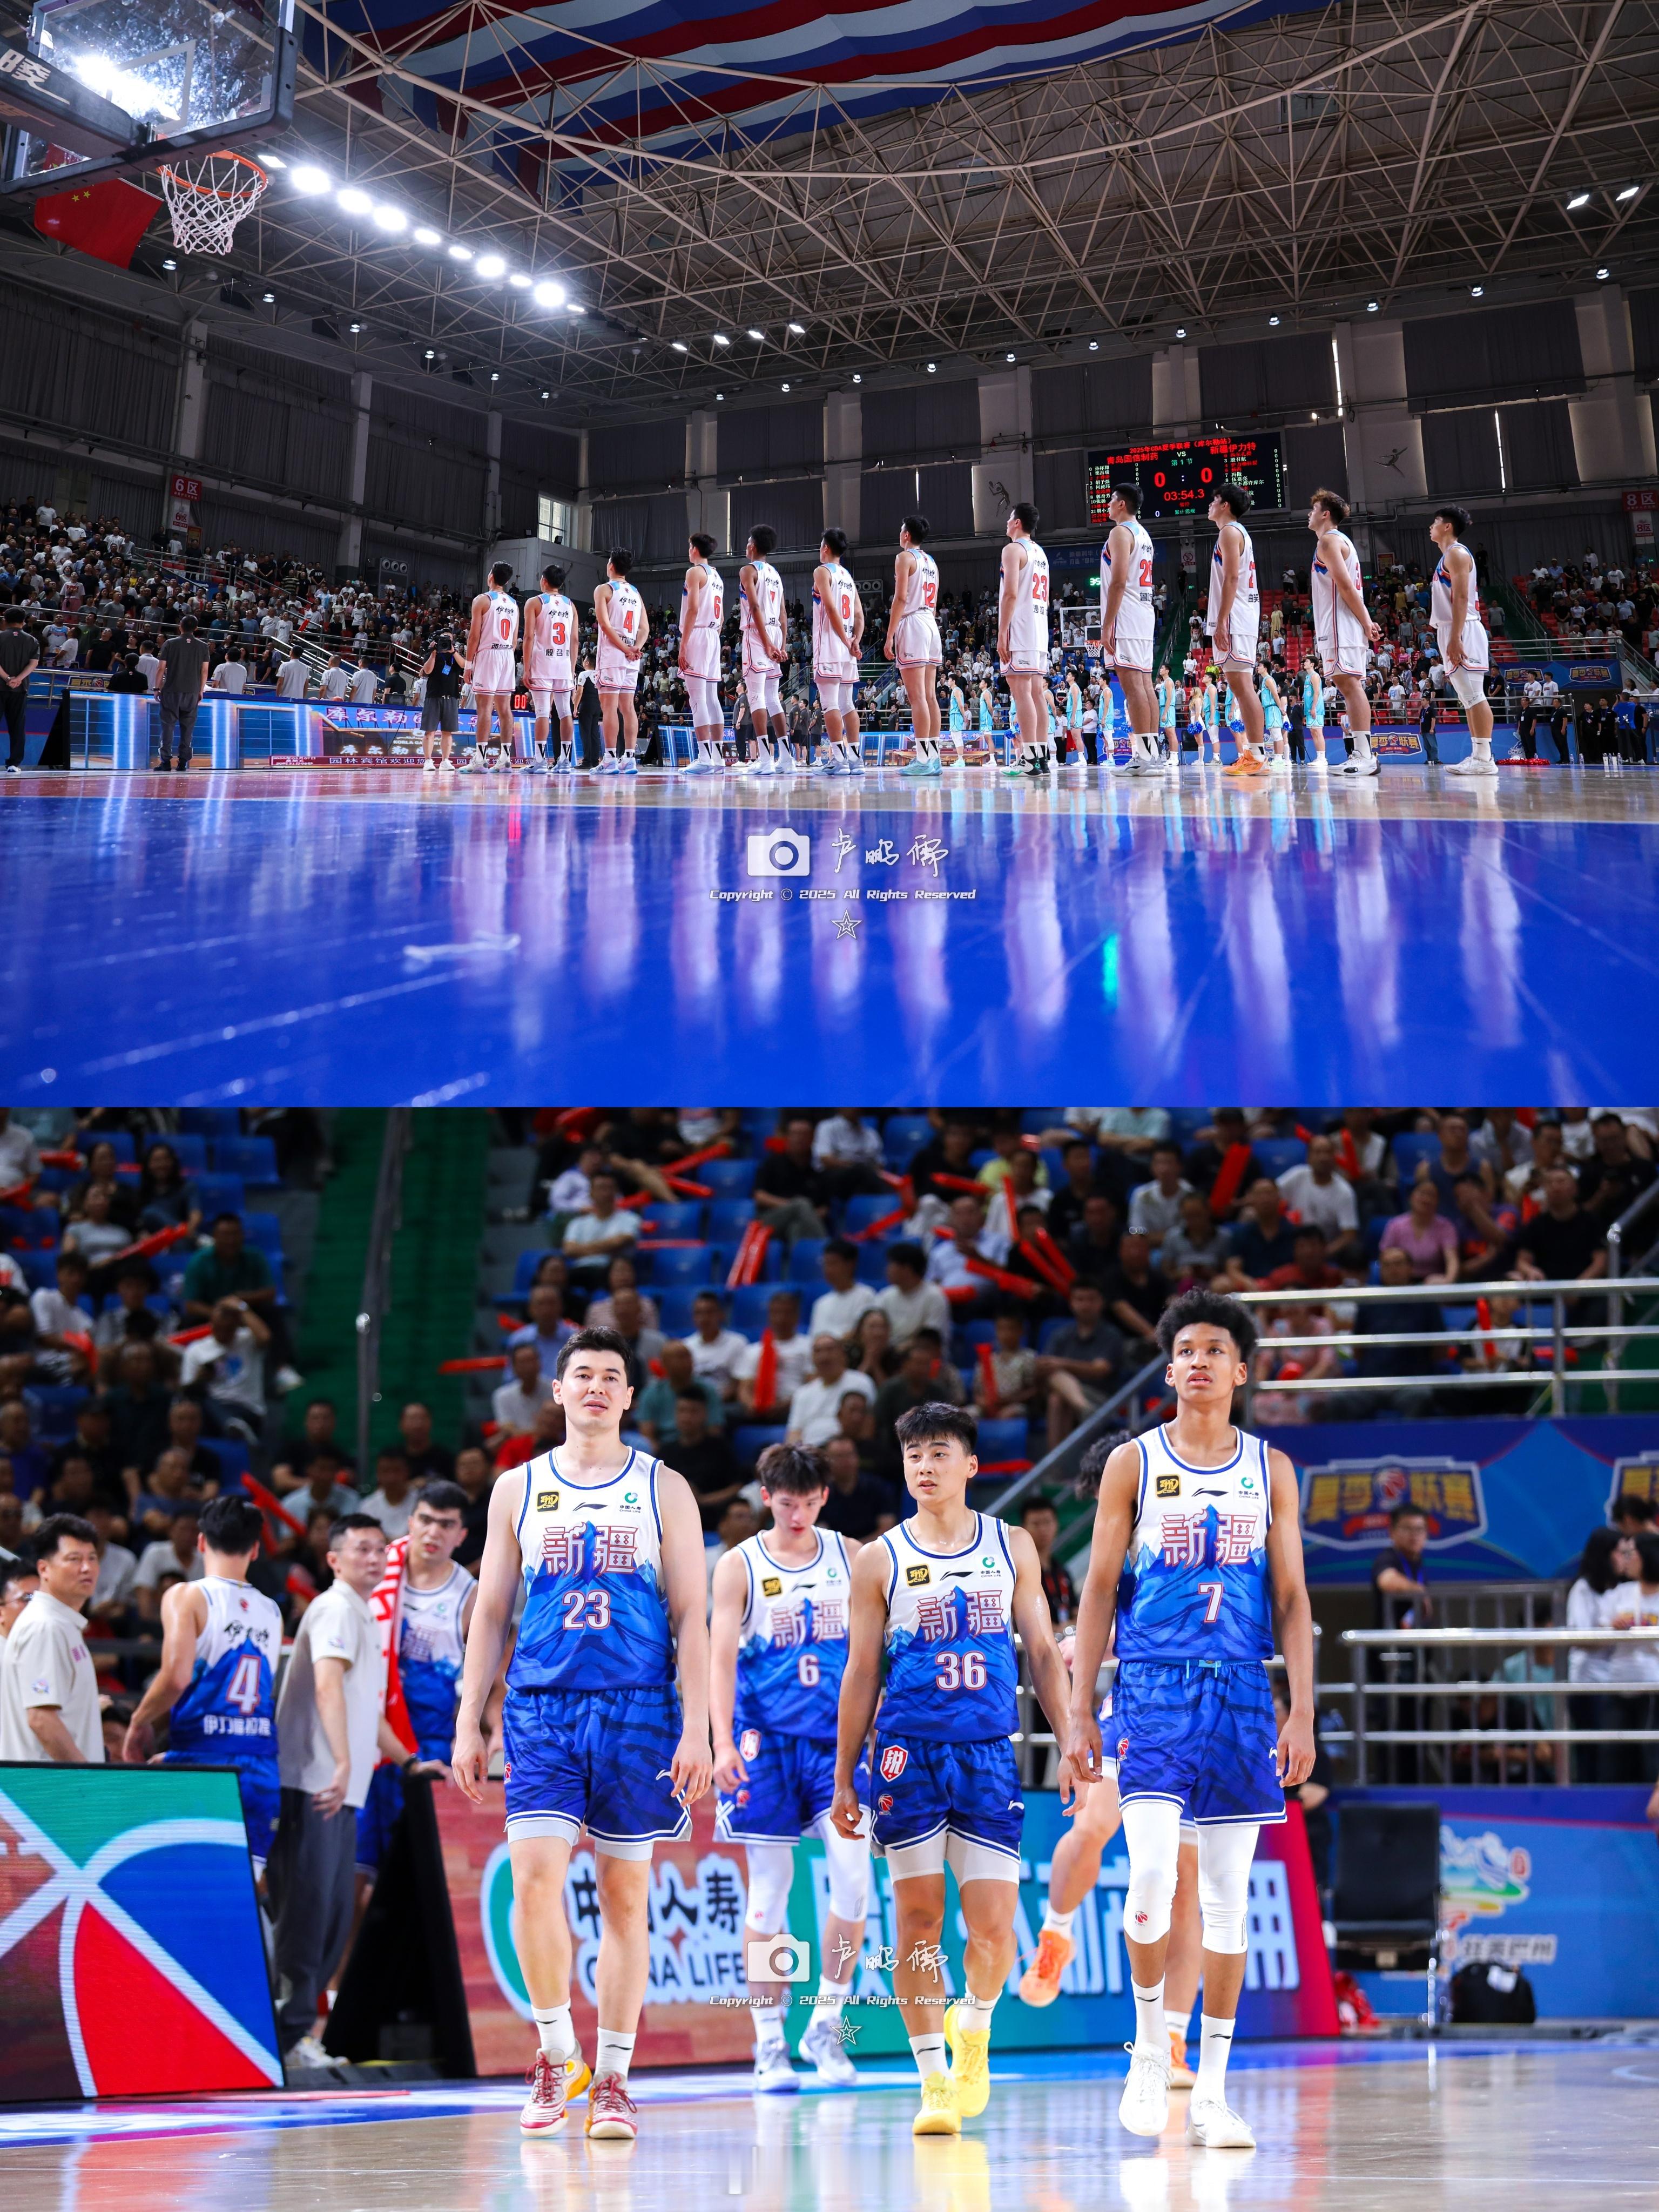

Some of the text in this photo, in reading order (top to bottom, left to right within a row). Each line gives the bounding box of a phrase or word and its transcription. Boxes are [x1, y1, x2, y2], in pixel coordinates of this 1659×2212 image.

[1107, 453, 1158, 464] 青岛国信制药
[1171, 458, 1192, 466] 第1节
[1210, 442, 1256, 454] 新疆伊力特
[1155, 472, 1165, 487] 0
[1201, 468, 1213, 483] 0
[1164, 488, 1205, 501] 03:54.3
[922, 582, 936, 608] 12
[1033, 573, 1048, 602] 23
[714, 595, 721, 619] 6
[841, 594, 850, 619] 8
[501, 618, 510, 640] 0
[553, 622, 566, 645] 3
[623, 610, 633, 633] 4
[542, 1522, 638, 1576] 新疆
[1161, 1509, 1258, 1568] 新疆
[563, 1590, 611, 1630] 23
[916, 1590, 1006, 1642] 新疆
[1198, 1582, 1224, 1623] 7
[771, 1600, 846, 1649] 新疆
[798, 1654, 820, 1688] 6
[935, 1650, 987, 1690] 36
[226, 1655, 261, 1715] 4
[571, 1867, 741, 1940] 中人寿
[585, 1951, 746, 1988] CNA LIFE
